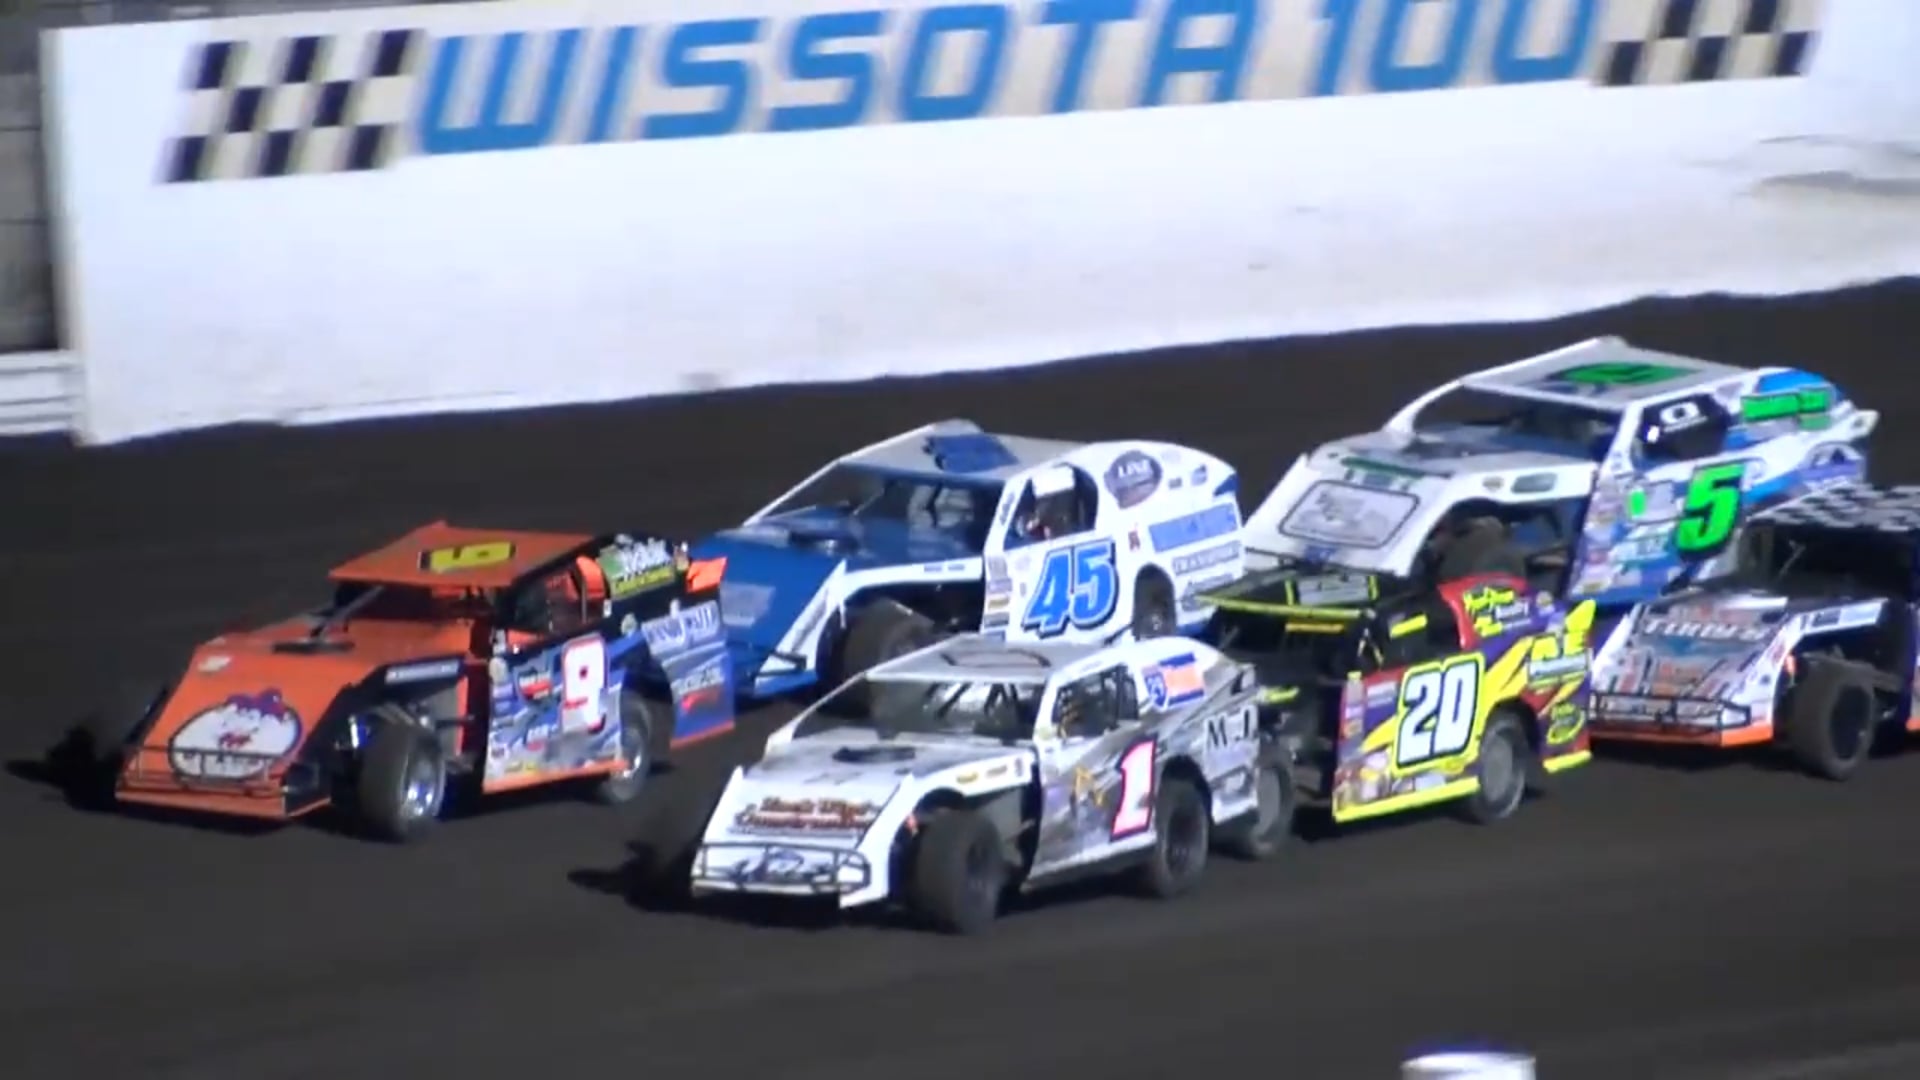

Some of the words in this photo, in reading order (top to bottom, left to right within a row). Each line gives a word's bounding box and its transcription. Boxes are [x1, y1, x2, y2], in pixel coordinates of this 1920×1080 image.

[418, 0, 1262, 155] WISSOTA
[1310, 0, 1598, 98] 100
[1676, 462, 1745, 553] 5
[1022, 537, 1120, 638] 45
[560, 634, 608, 734] 9
[1392, 652, 1482, 777] 20
[1108, 733, 1160, 843] 1
